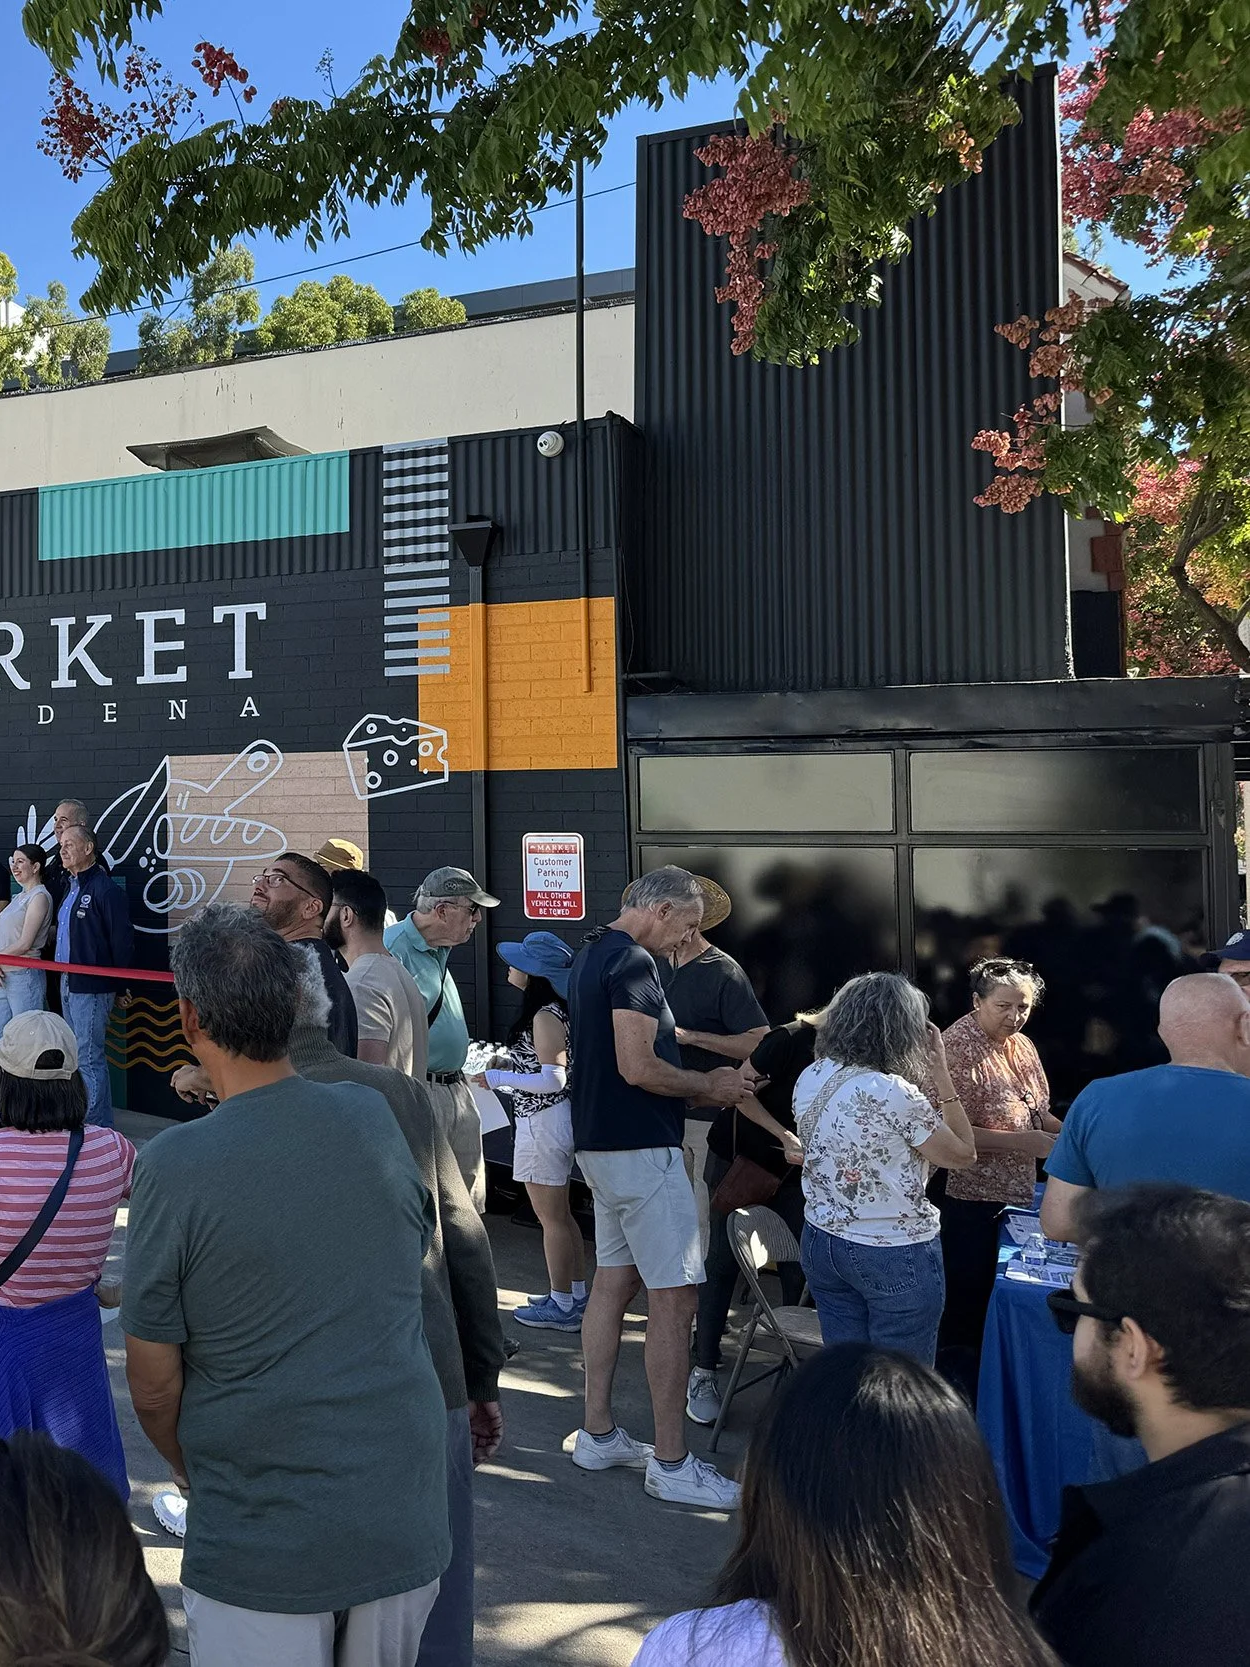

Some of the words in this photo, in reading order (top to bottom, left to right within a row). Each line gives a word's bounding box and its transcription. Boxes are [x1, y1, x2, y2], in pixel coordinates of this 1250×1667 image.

[534, 857, 572, 865] Customer
[537, 868, 569, 879] Parking
[544, 880, 563, 889] Only
